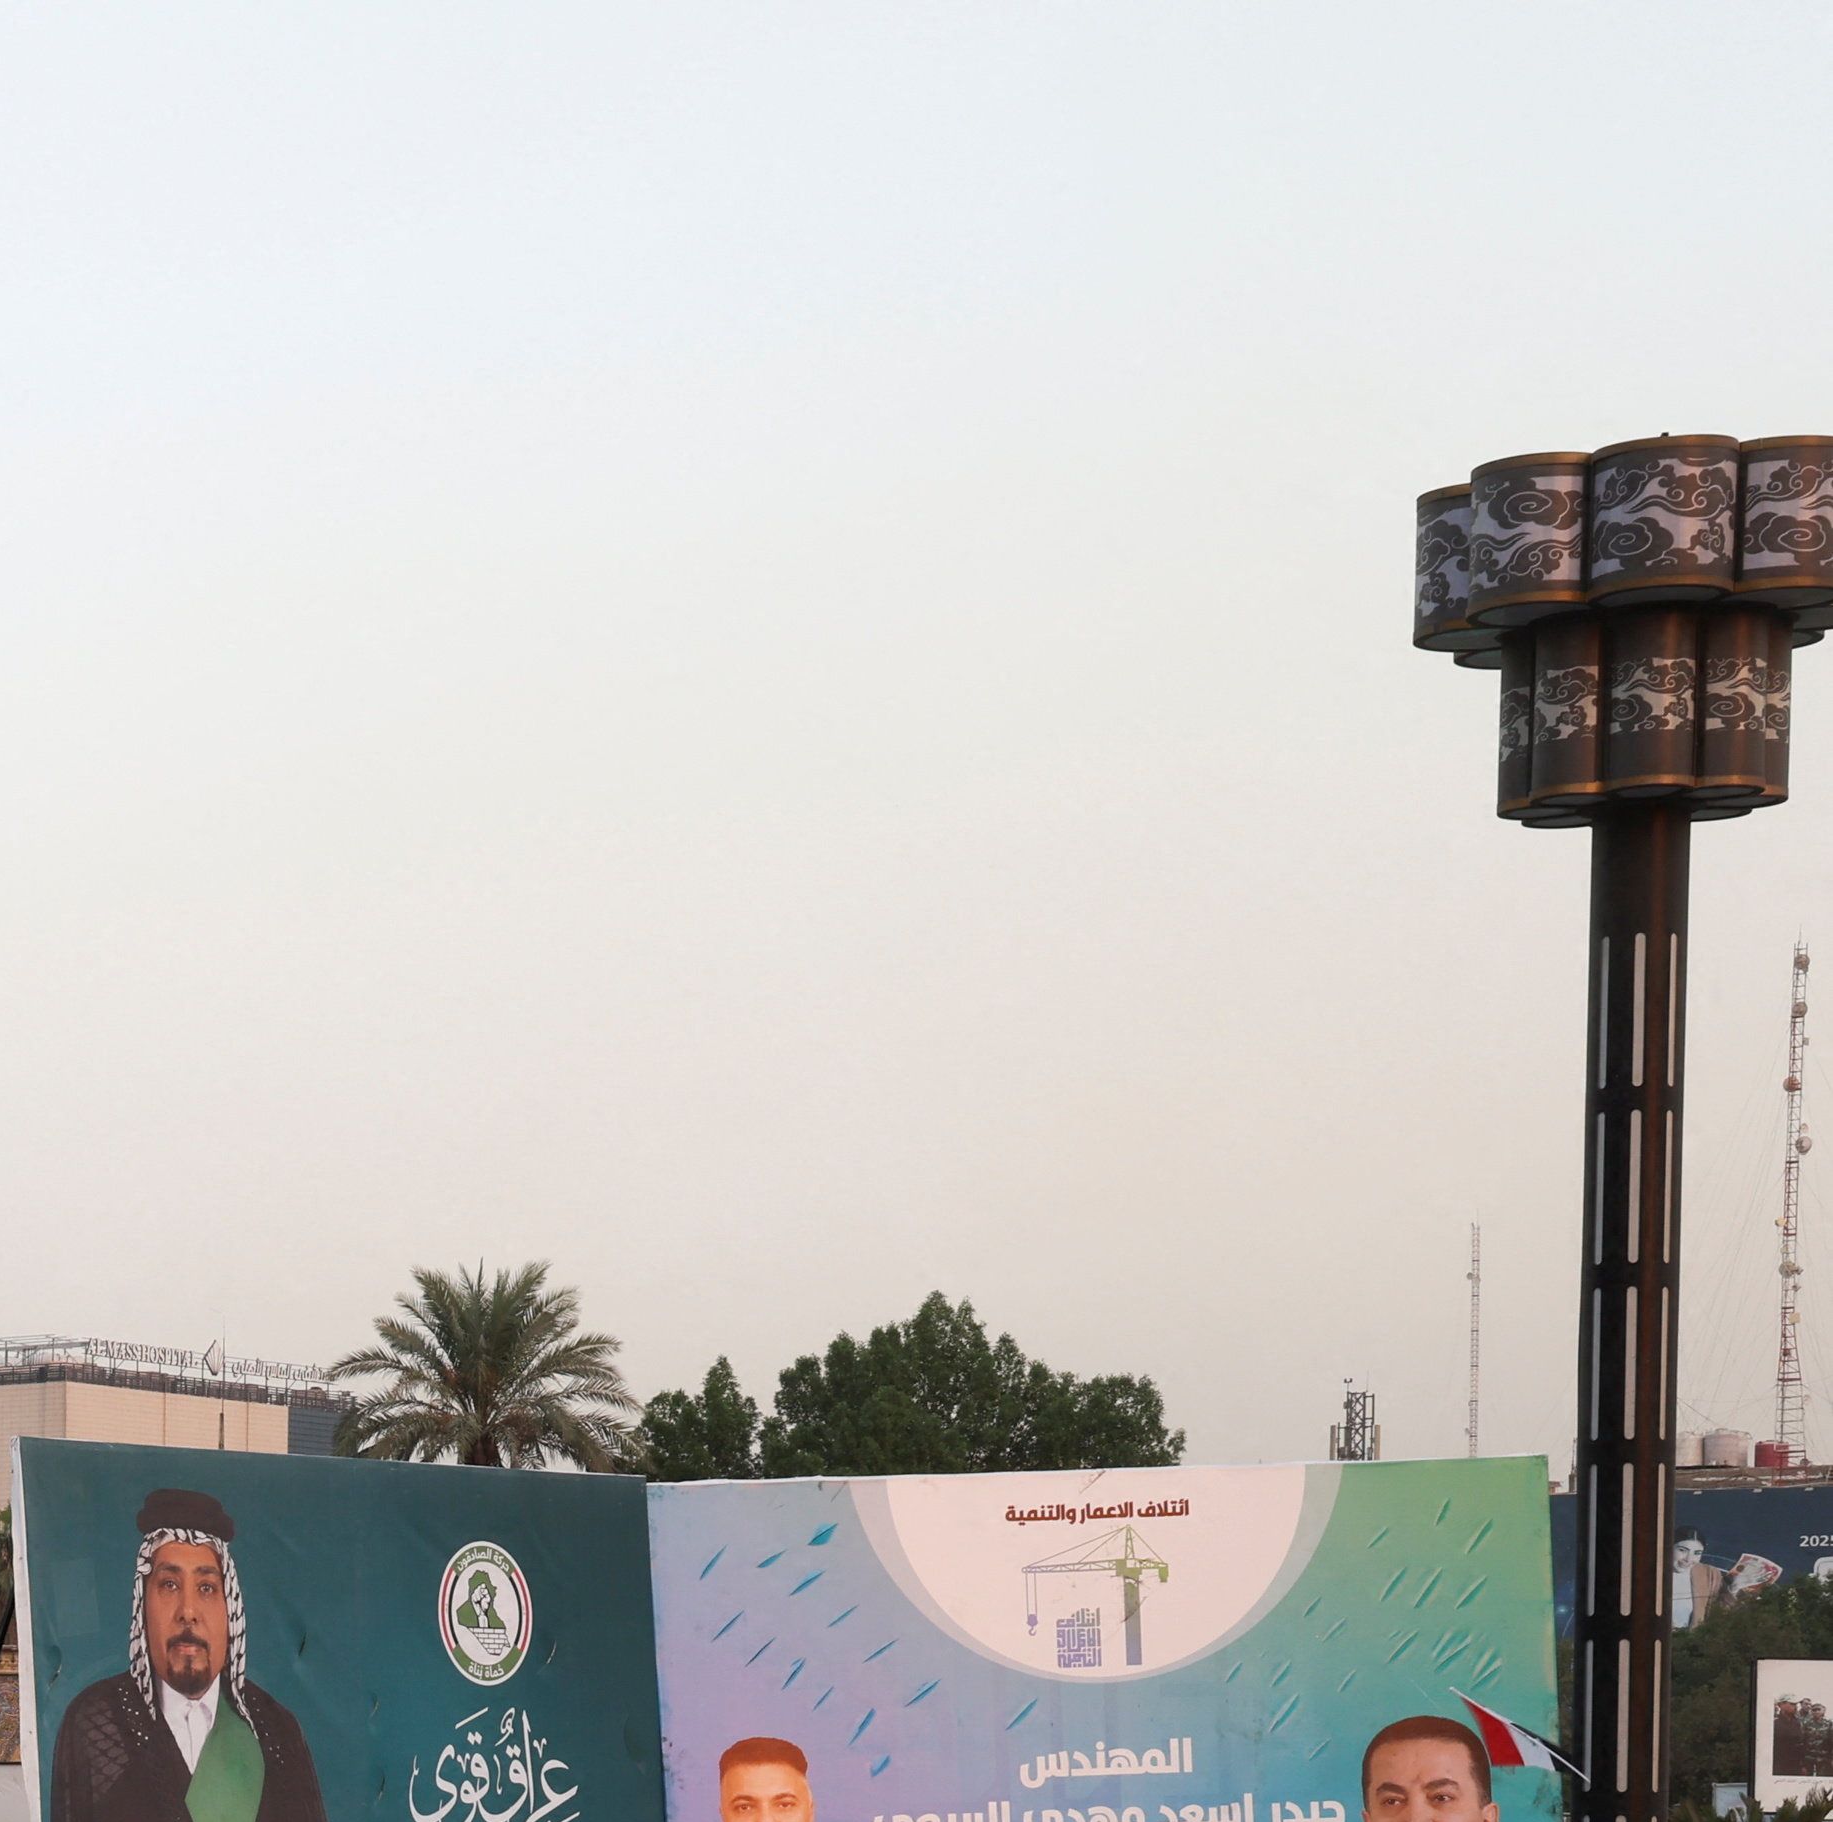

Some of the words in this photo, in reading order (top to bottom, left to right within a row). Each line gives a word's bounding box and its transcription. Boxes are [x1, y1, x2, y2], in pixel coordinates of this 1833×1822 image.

[1005, 1504, 1077, 1526] والتنمية
[1080, 1501, 1134, 1525] الاعمار
[1137, 1498, 1190, 1518] ائتلاف
[1019, 1737, 1193, 1789] المهندس
